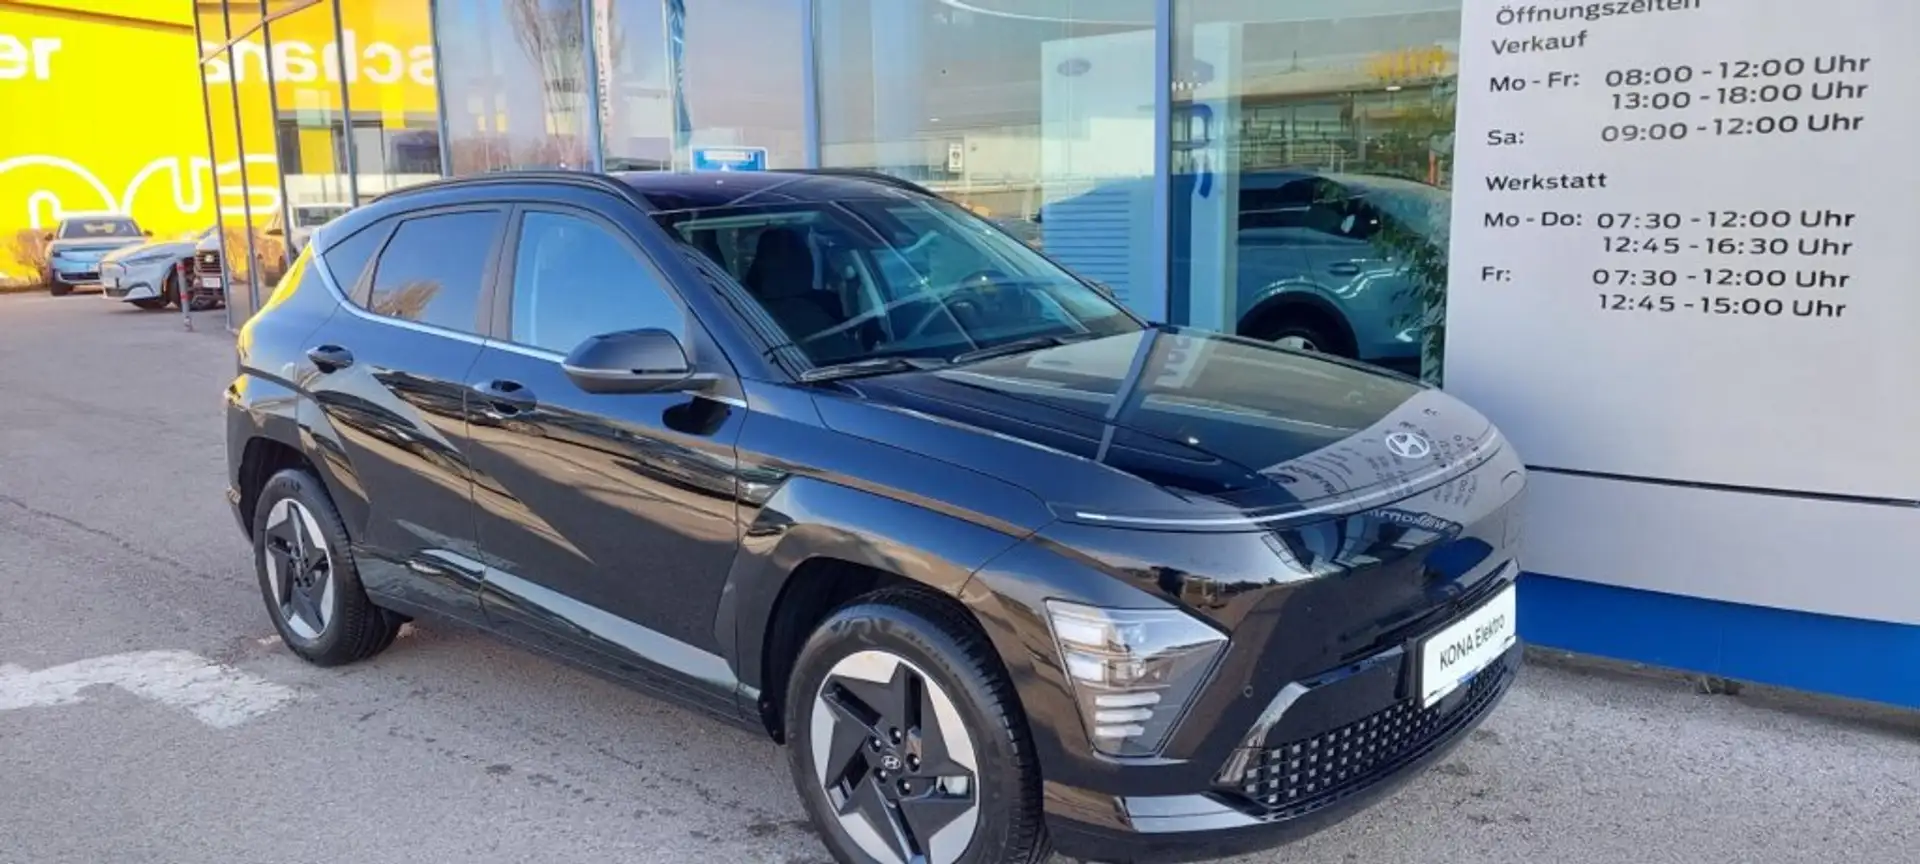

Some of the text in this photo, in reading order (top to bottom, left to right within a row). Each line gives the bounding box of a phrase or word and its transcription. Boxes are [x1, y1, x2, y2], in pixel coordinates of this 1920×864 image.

[1491, 29, 1588, 56] Verkauf
[1489, 75, 1526, 93] Mo
[1547, 71, 1580, 89] Fr:
[1604, 65, 1693, 88] 08:00
[1719, 57, 1805, 80] 12:00
[1813, 54, 1871, 75] Uhr
[1612, 91, 1691, 110] 13:00
[1716, 83, 1803, 105] 18:00
[1811, 80, 1869, 101] Uhr
[1487, 129, 1525, 146] Sa:
[1601, 121, 1688, 143] 09:00
[1713, 115, 1799, 136] 12:00
[1807, 112, 1864, 133] Uhr
[1485, 172, 1608, 192] Werkstatt
[1484, 211, 1520, 228] Mo
[1541, 211, 1582, 227] Do:
[1597, 212, 1682, 230] 07:30
[1707, 210, 1792, 228] 12:00
[1800, 209, 1856, 228] Uhr
[1603, 236, 1680, 254] 12:45
[1705, 237, 1789, 256] 16:30
[1797, 237, 1853, 256] Uhr
[1481, 265, 1511, 282] Fr:
[1592, 268, 1678, 287] 07:30
[1703, 268, 1787, 287] 12:00
[1795, 270, 1851, 288] Uhr
[1599, 293, 1676, 313] 12:45
[1701, 296, 1783, 317] 15:00
[1792, 299, 1847, 318] Uhr
[1439, 614, 1506, 671] KONA Elektro
